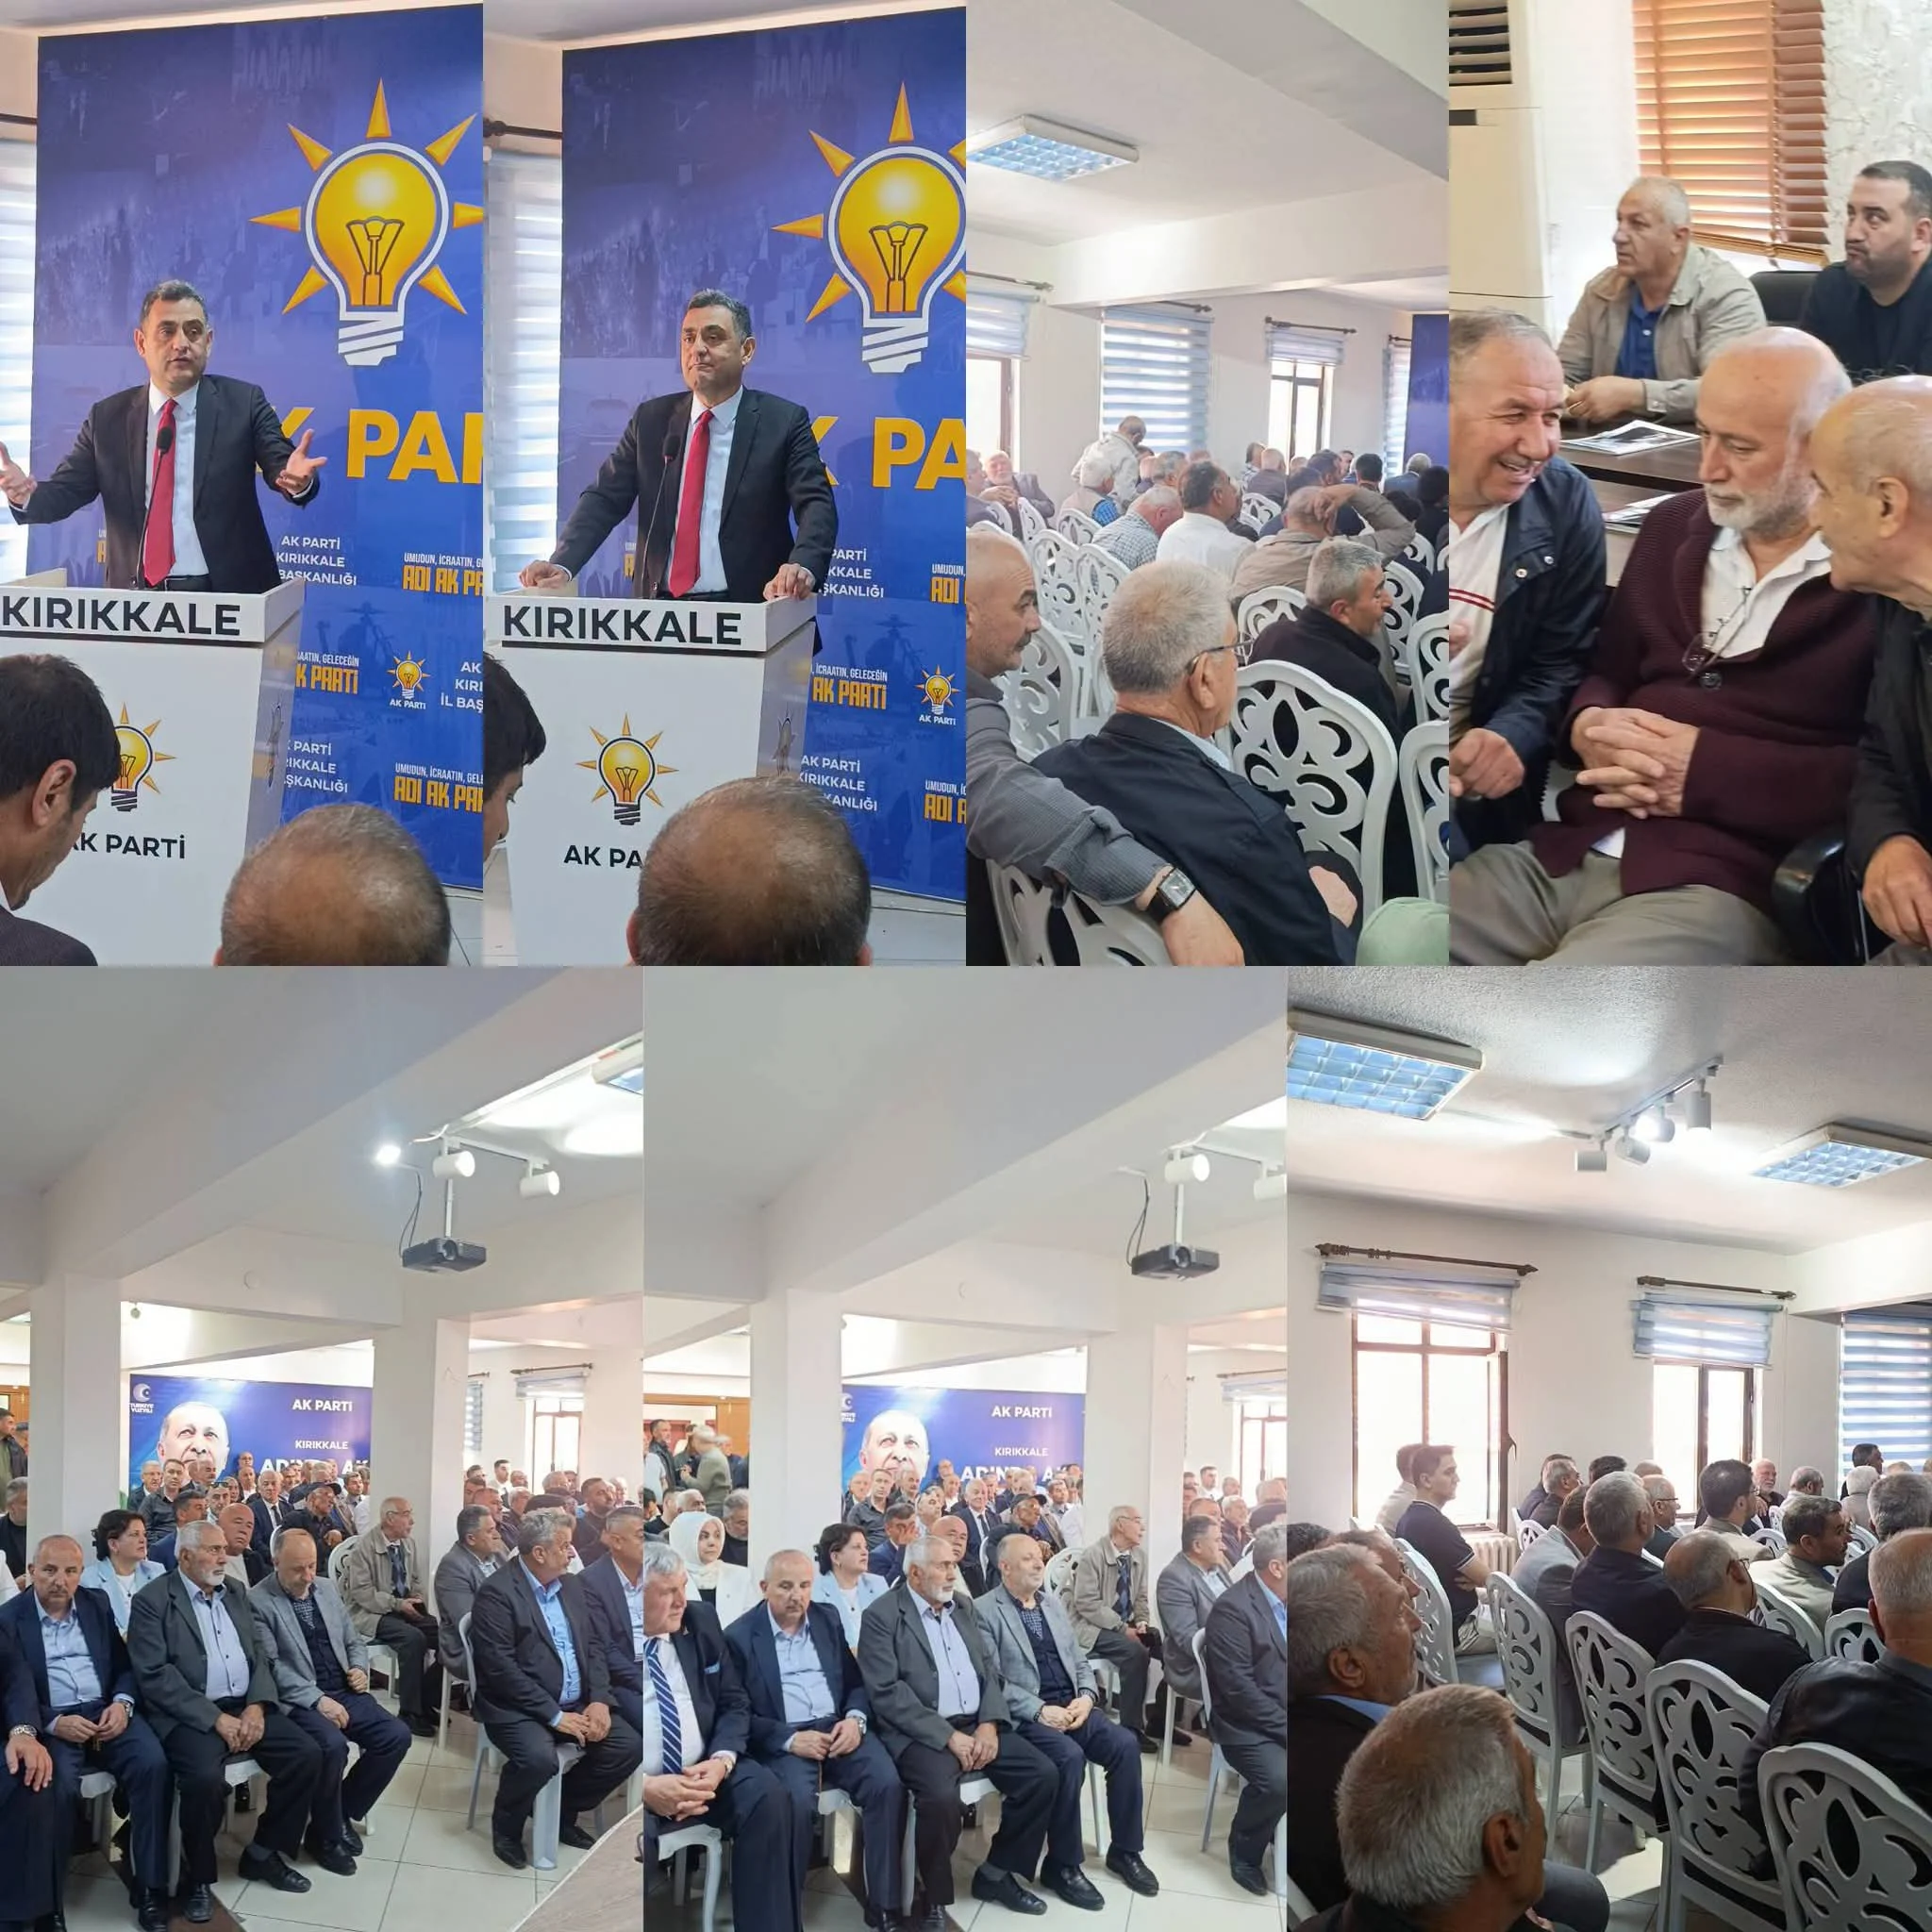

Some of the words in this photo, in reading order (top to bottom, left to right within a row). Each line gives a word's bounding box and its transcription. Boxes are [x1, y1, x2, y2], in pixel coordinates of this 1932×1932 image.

[281, 536, 299, 546] AK
[302, 537, 341, 550] PARTİ
[275, 552, 345, 568] KIRIKKALE
[404, 552, 438, 565] UMUDUN,
[439, 554, 475, 569] İCRAATIN,
[932, 563, 966, 577] UMUDUN,
[403, 565, 431, 591] ADI
[435, 567, 459, 594] AK
[818, 583, 885, 598] ŞKANLIĞI
[930, 576, 959, 604] ADI
[3, 595, 241, 636] KIRIKKALE
[504, 605, 741, 645] KIRIKKALE
[460, 661, 481, 674] AK
[816, 662, 849, 678] İCRAATIN,
[850, 668, 888, 682] GELECEĞİN
[310, 665, 358, 694] PARTİ
[441, 692, 454, 707] İL
[812, 676, 834, 704] AK
[838, 679, 887, 710] PARTİ
[389, 699, 402, 708] AK
[919, 714, 932, 724] AK
[293, 741, 332, 756] PARTİ
[286, 758, 337, 774] IKKALE
[395, 762, 428, 778] UMUDUN,
[429, 766, 466, 784] İCRAATIN,
[801, 755, 819, 767] AK
[822, 758, 860, 774] PARTİ
[284, 774, 348, 793] ŞKANLIĞI
[393, 775, 422, 805] ADI
[426, 779, 450, 808] AK
[925, 779, 959, 796] UMUDUN,
[924, 793, 953, 823] ADI
[106, 834, 185, 859] PARTİ
[563, 844, 601, 866] AK
[292, 1398, 311, 1410] AK
[991, 1406, 1011, 1418] AK
[294, 1440, 349, 1450] KIRIKKALE
[994, 1447, 1049, 1457] KIRIKKALE
